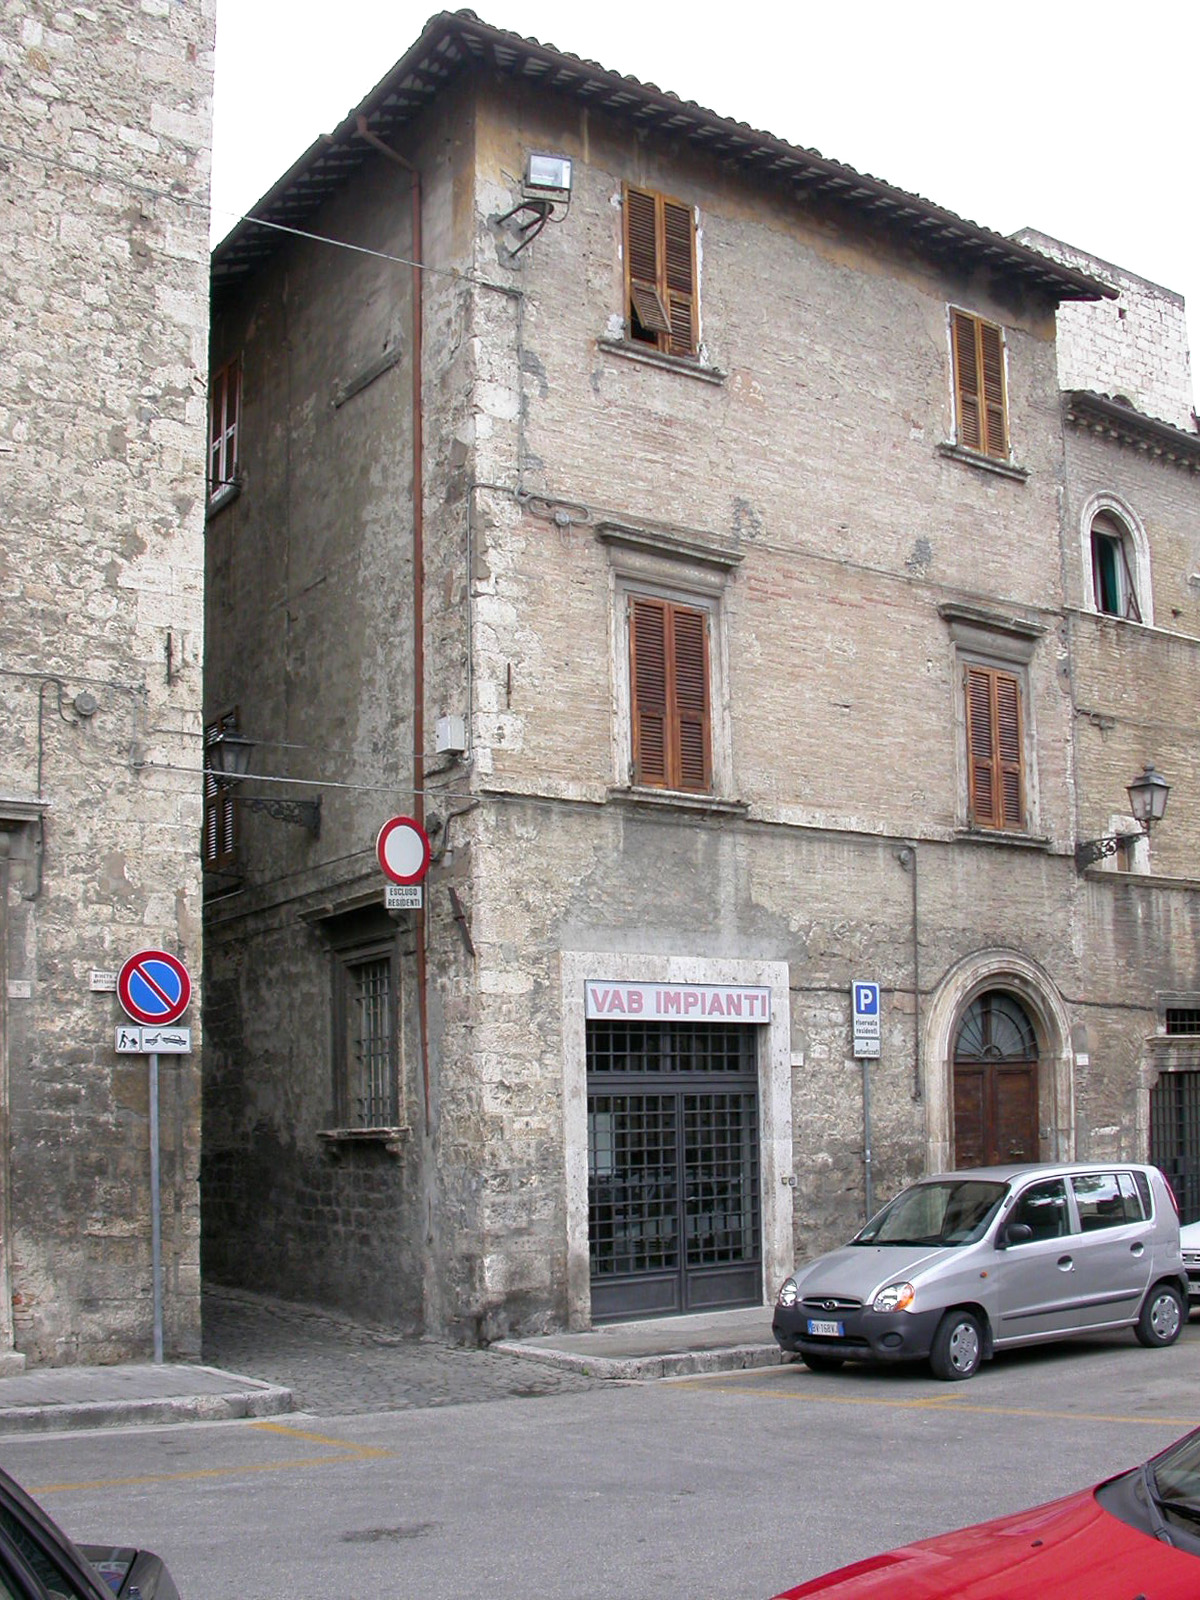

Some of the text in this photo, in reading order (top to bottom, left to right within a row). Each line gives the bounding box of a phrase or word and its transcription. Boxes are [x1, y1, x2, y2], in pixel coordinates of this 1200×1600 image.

[389, 887, 418, 896] ESCLUSO
[388, 898, 421, 907] RESIDENTI
[590, 988, 767, 1017] VAB IMPIANTI
[859, 988, 873, 1011] P
[856, 1027, 878, 1035] residenti
